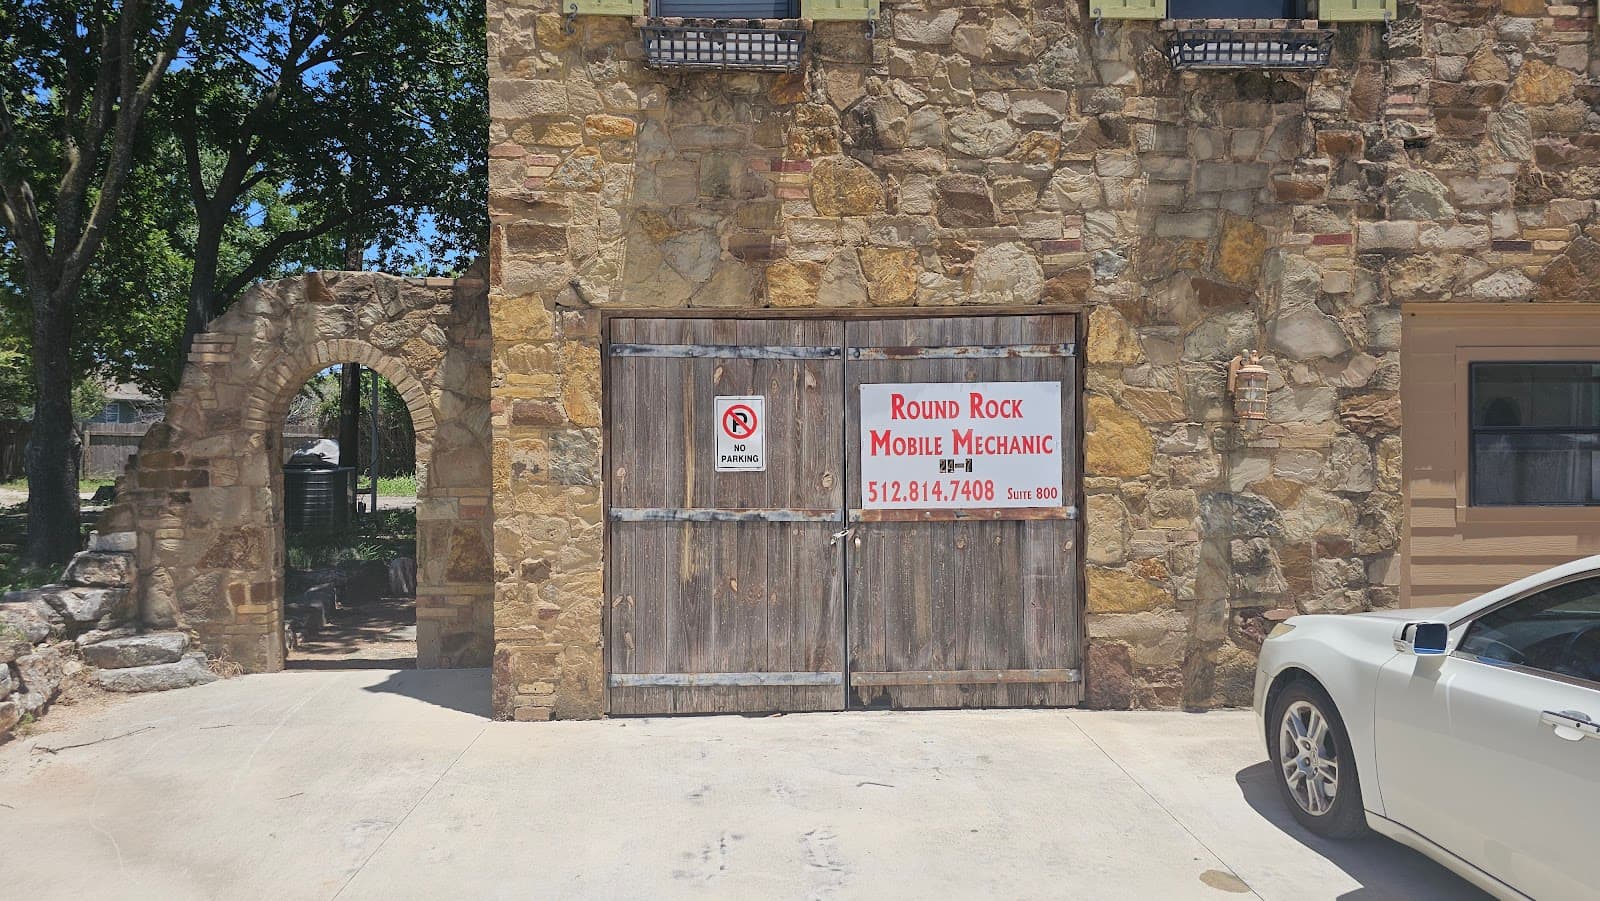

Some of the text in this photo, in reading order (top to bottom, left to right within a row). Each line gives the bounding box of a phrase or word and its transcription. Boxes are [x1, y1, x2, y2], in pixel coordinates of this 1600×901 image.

[891, 392, 1023, 420] ROUND ROCK
[734, 444, 746, 452] NO
[869, 428, 1053, 456] MOBILE MECHANIC
[721, 454, 759, 463] PARKING
[868, 479, 1058, 503] 512.814.7408 SUITE 800
